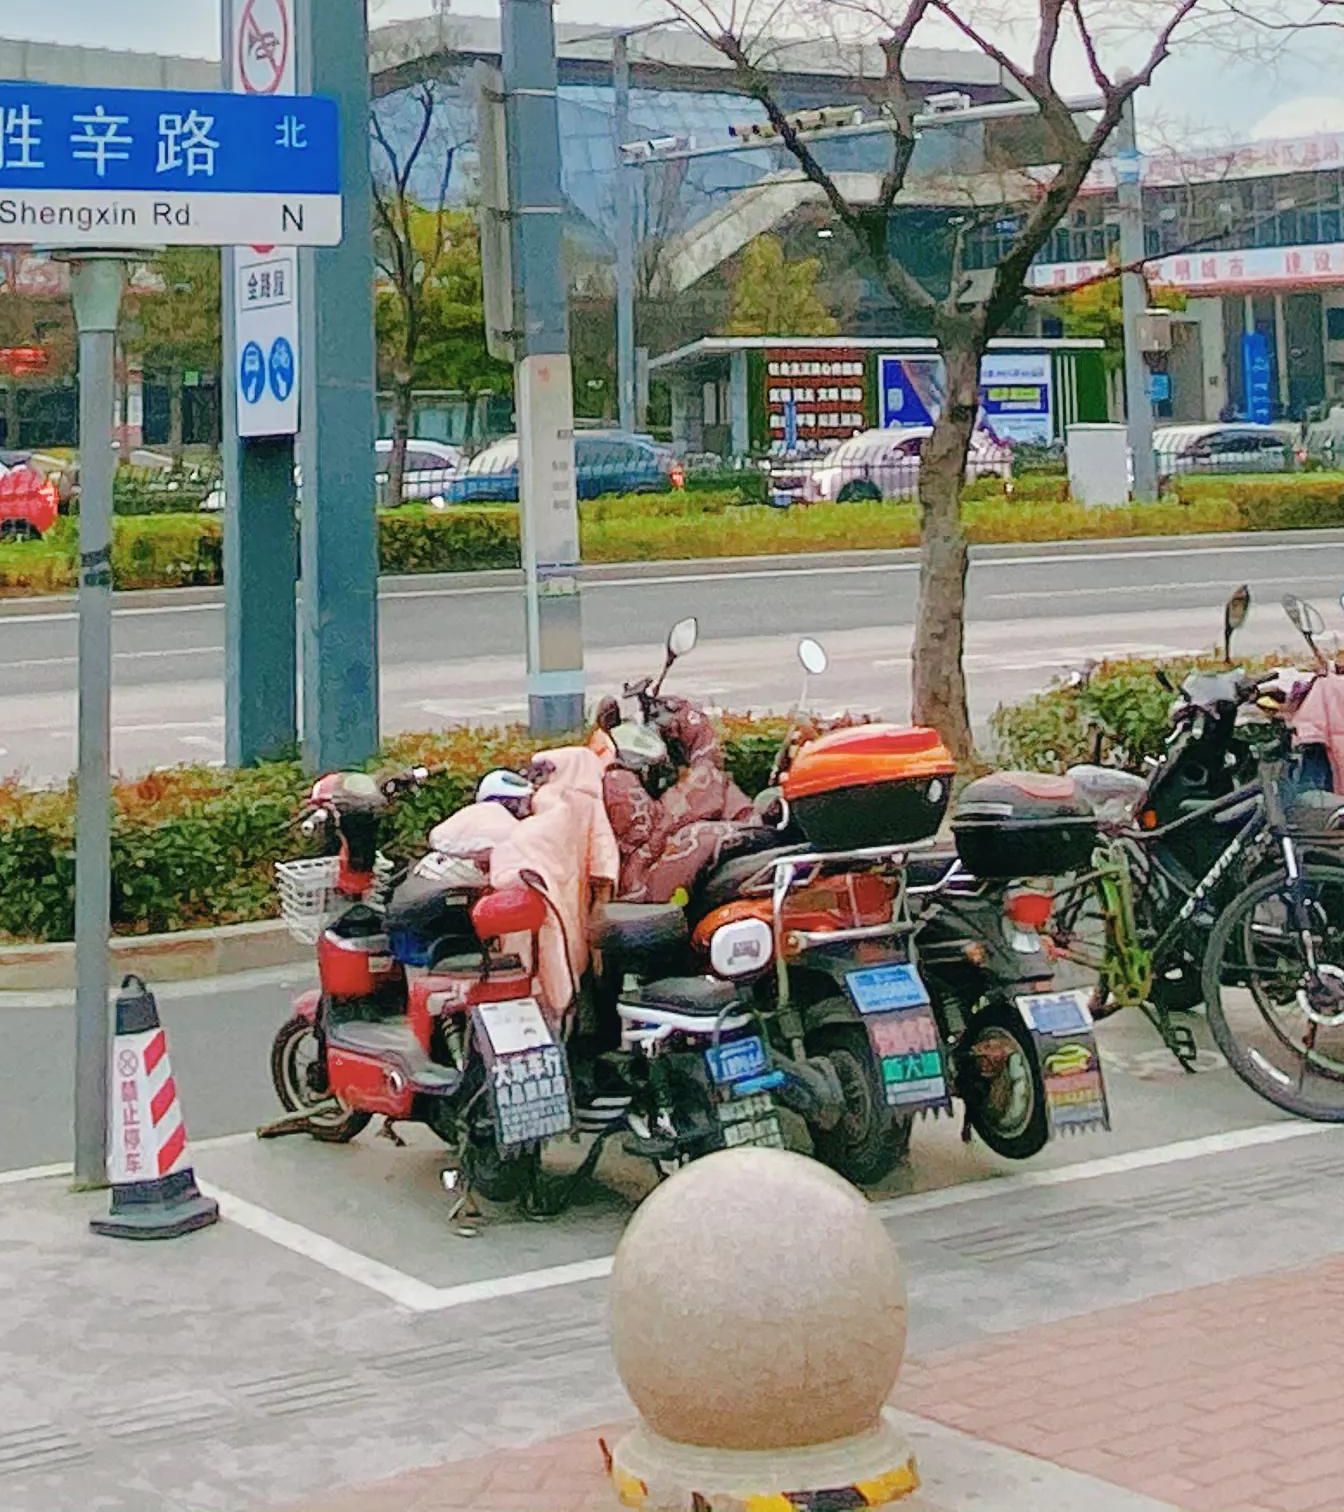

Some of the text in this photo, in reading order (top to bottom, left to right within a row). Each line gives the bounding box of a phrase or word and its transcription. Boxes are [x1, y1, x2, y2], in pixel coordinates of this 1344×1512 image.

[274, 114, 308, 148] 北
[281, 204, 305, 232] N
[121, 1080, 142, 1174] 禁止停车
